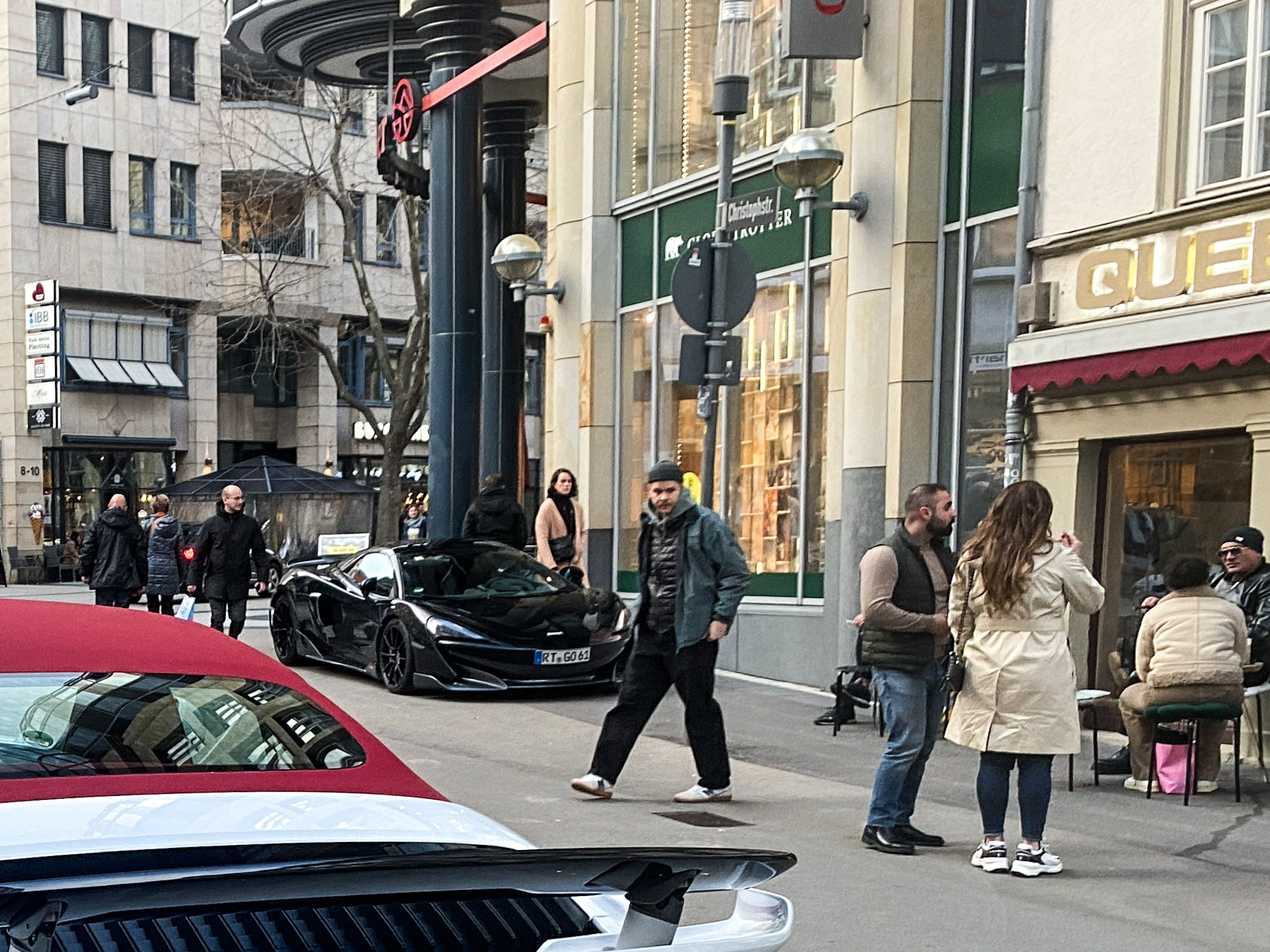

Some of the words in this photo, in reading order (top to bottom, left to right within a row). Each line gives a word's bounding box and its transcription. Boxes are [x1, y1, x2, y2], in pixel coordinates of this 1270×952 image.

[728, 194, 774, 223] Christophstr.
[34, 311, 49, 323] IBB
[542, 652, 557, 663] RT
[578, 650, 589, 660] 61
